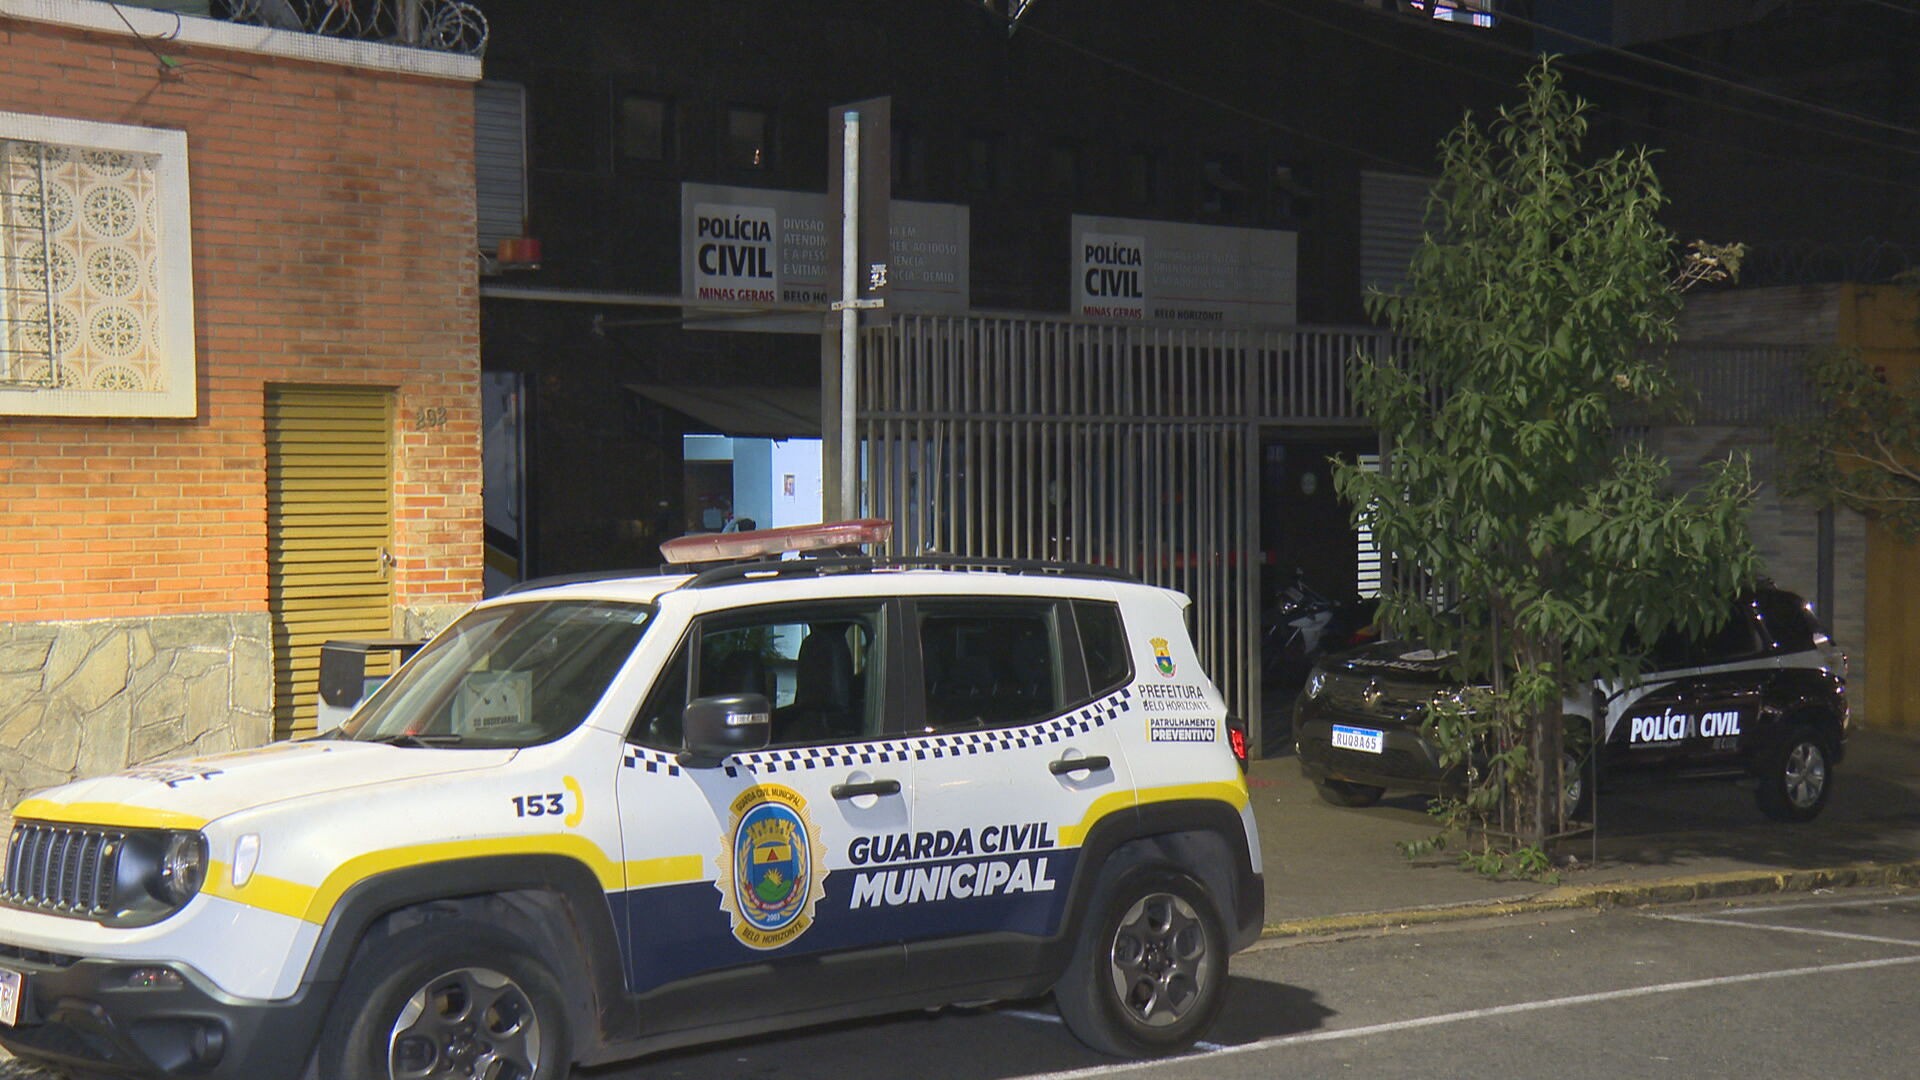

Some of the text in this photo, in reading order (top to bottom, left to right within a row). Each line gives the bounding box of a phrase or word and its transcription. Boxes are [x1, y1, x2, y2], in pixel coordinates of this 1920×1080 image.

[698, 214, 771, 242] POLÍCIA
[698, 243, 773, 278] CIVIL
[1085, 242, 1142, 267] POLÍCIA
[699, 286, 775, 302] MINAS GERAIS
[1085, 268, 1143, 298] CIVIL
[783, 290, 810, 303] BELO
[1083, 306, 1142, 320] MINAS GERAIS
[1177, 309, 1224, 321] HORIZONTE
[1138, 684, 1204, 699] PREFEITURA
[1143, 700, 1212, 712] BELO HORIZONTE
[1150, 718, 1216, 727] PATRULHAMENTO
[1630, 707, 1741, 743] POLÍCIA CIVIL
[1152, 728, 1215, 742] PREVENTIVO
[1336, 733, 1377, 750] RUQ8A65
[511, 792, 565, 817] 153
[735, 790, 755, 812] GUARDA
[771, 788, 801, 808] MUNICIPAL
[848, 821, 1055, 866] GUARDA CIVIL
[850, 856, 1056, 910] MUNICIPAL
[742, 922, 804, 944] BELO HORIZONTE
